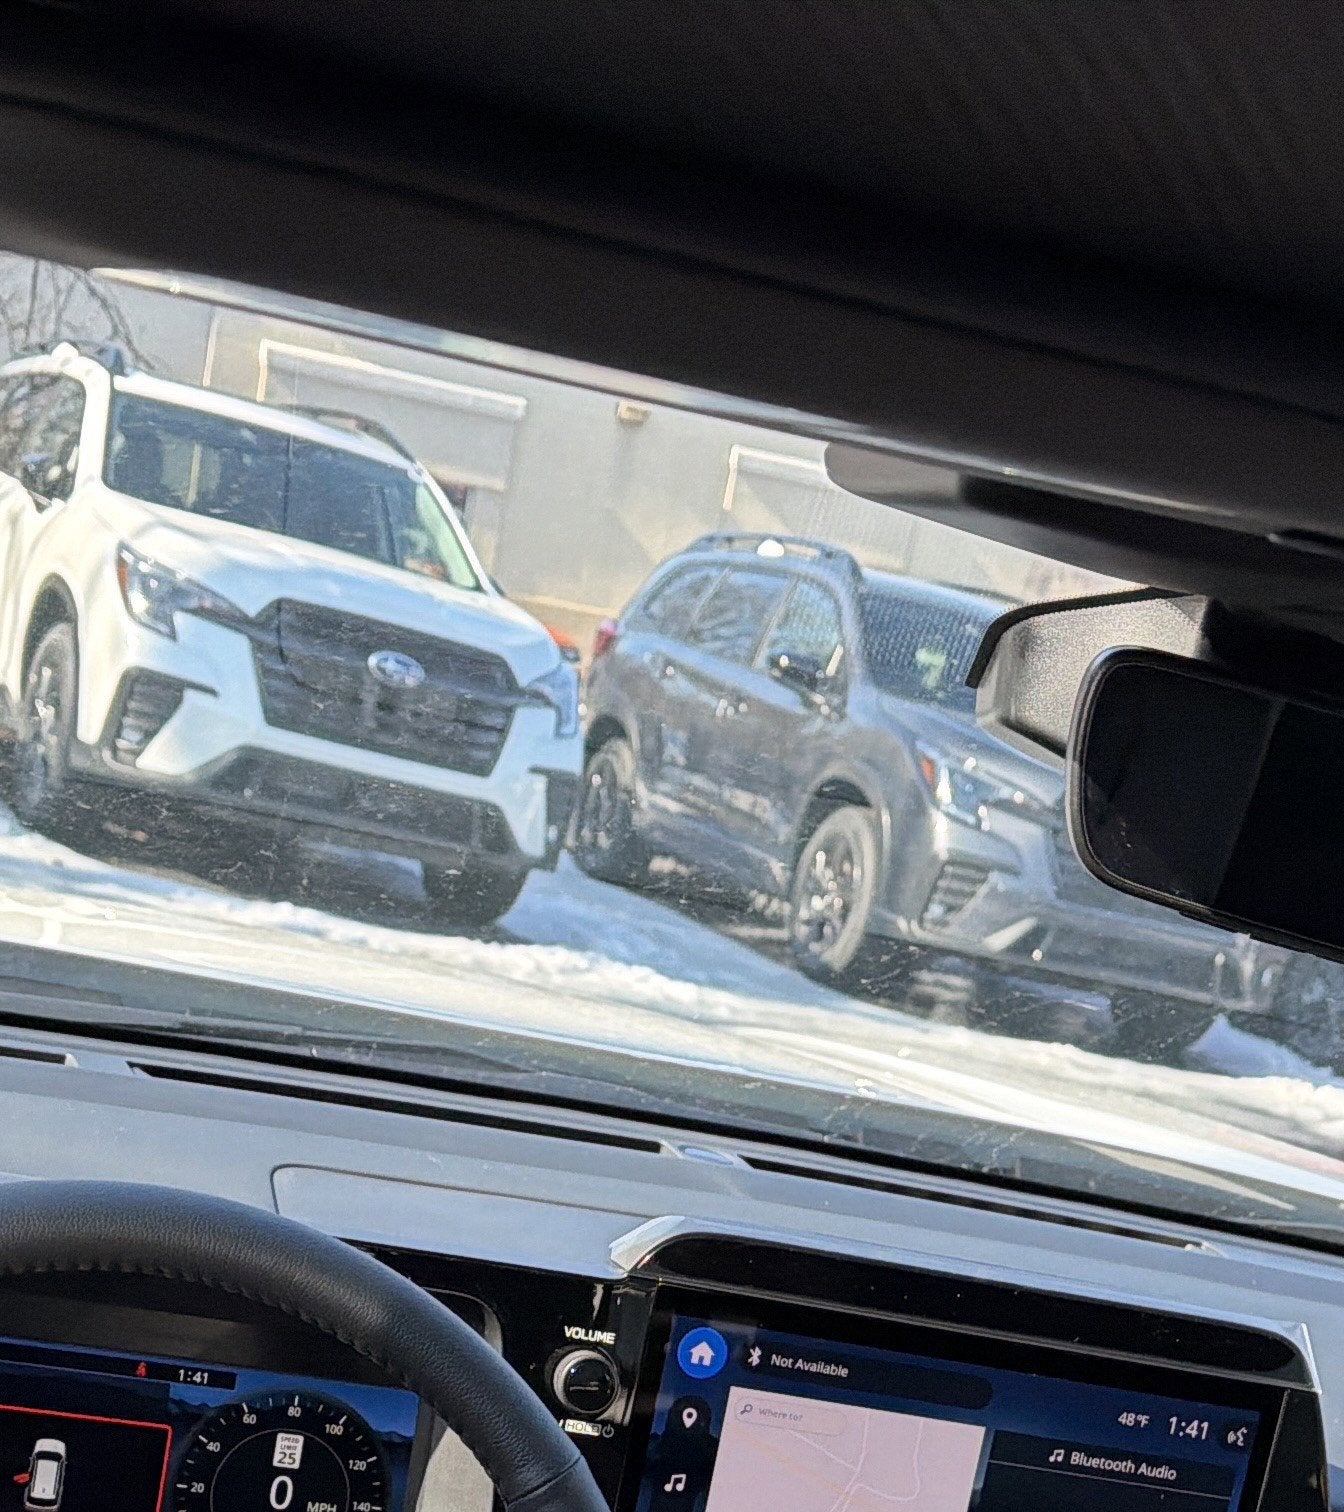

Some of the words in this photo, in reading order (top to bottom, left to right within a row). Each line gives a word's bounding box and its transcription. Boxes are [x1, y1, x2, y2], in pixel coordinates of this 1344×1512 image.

[563, 1325, 616, 1345] VOLUME
[770, 1353, 795, 1370] Not
[795, 1357, 850, 1378] Available
[178, 1368, 209, 1385] 1:41
[243, 1413, 257, 1425] 60
[287, 1406, 302, 1418] 80
[1117, 1411, 1150, 1428] 48°F
[325, 1423, 345, 1436] 100
[1168, 1416, 1210, 1441] 1:41
[206, 1441, 221, 1453] 40
[276, 1451, 297, 1465] 25
[348, 1459, 367, 1471] 120
[1069, 1451, 1136, 1475] Bluetooth
[1137, 1462, 1177, 1481] Audio
[190, 1482, 205, 1494] 20
[269, 1475, 293, 1510] 0
[352, 1501, 371, 1512] 140
